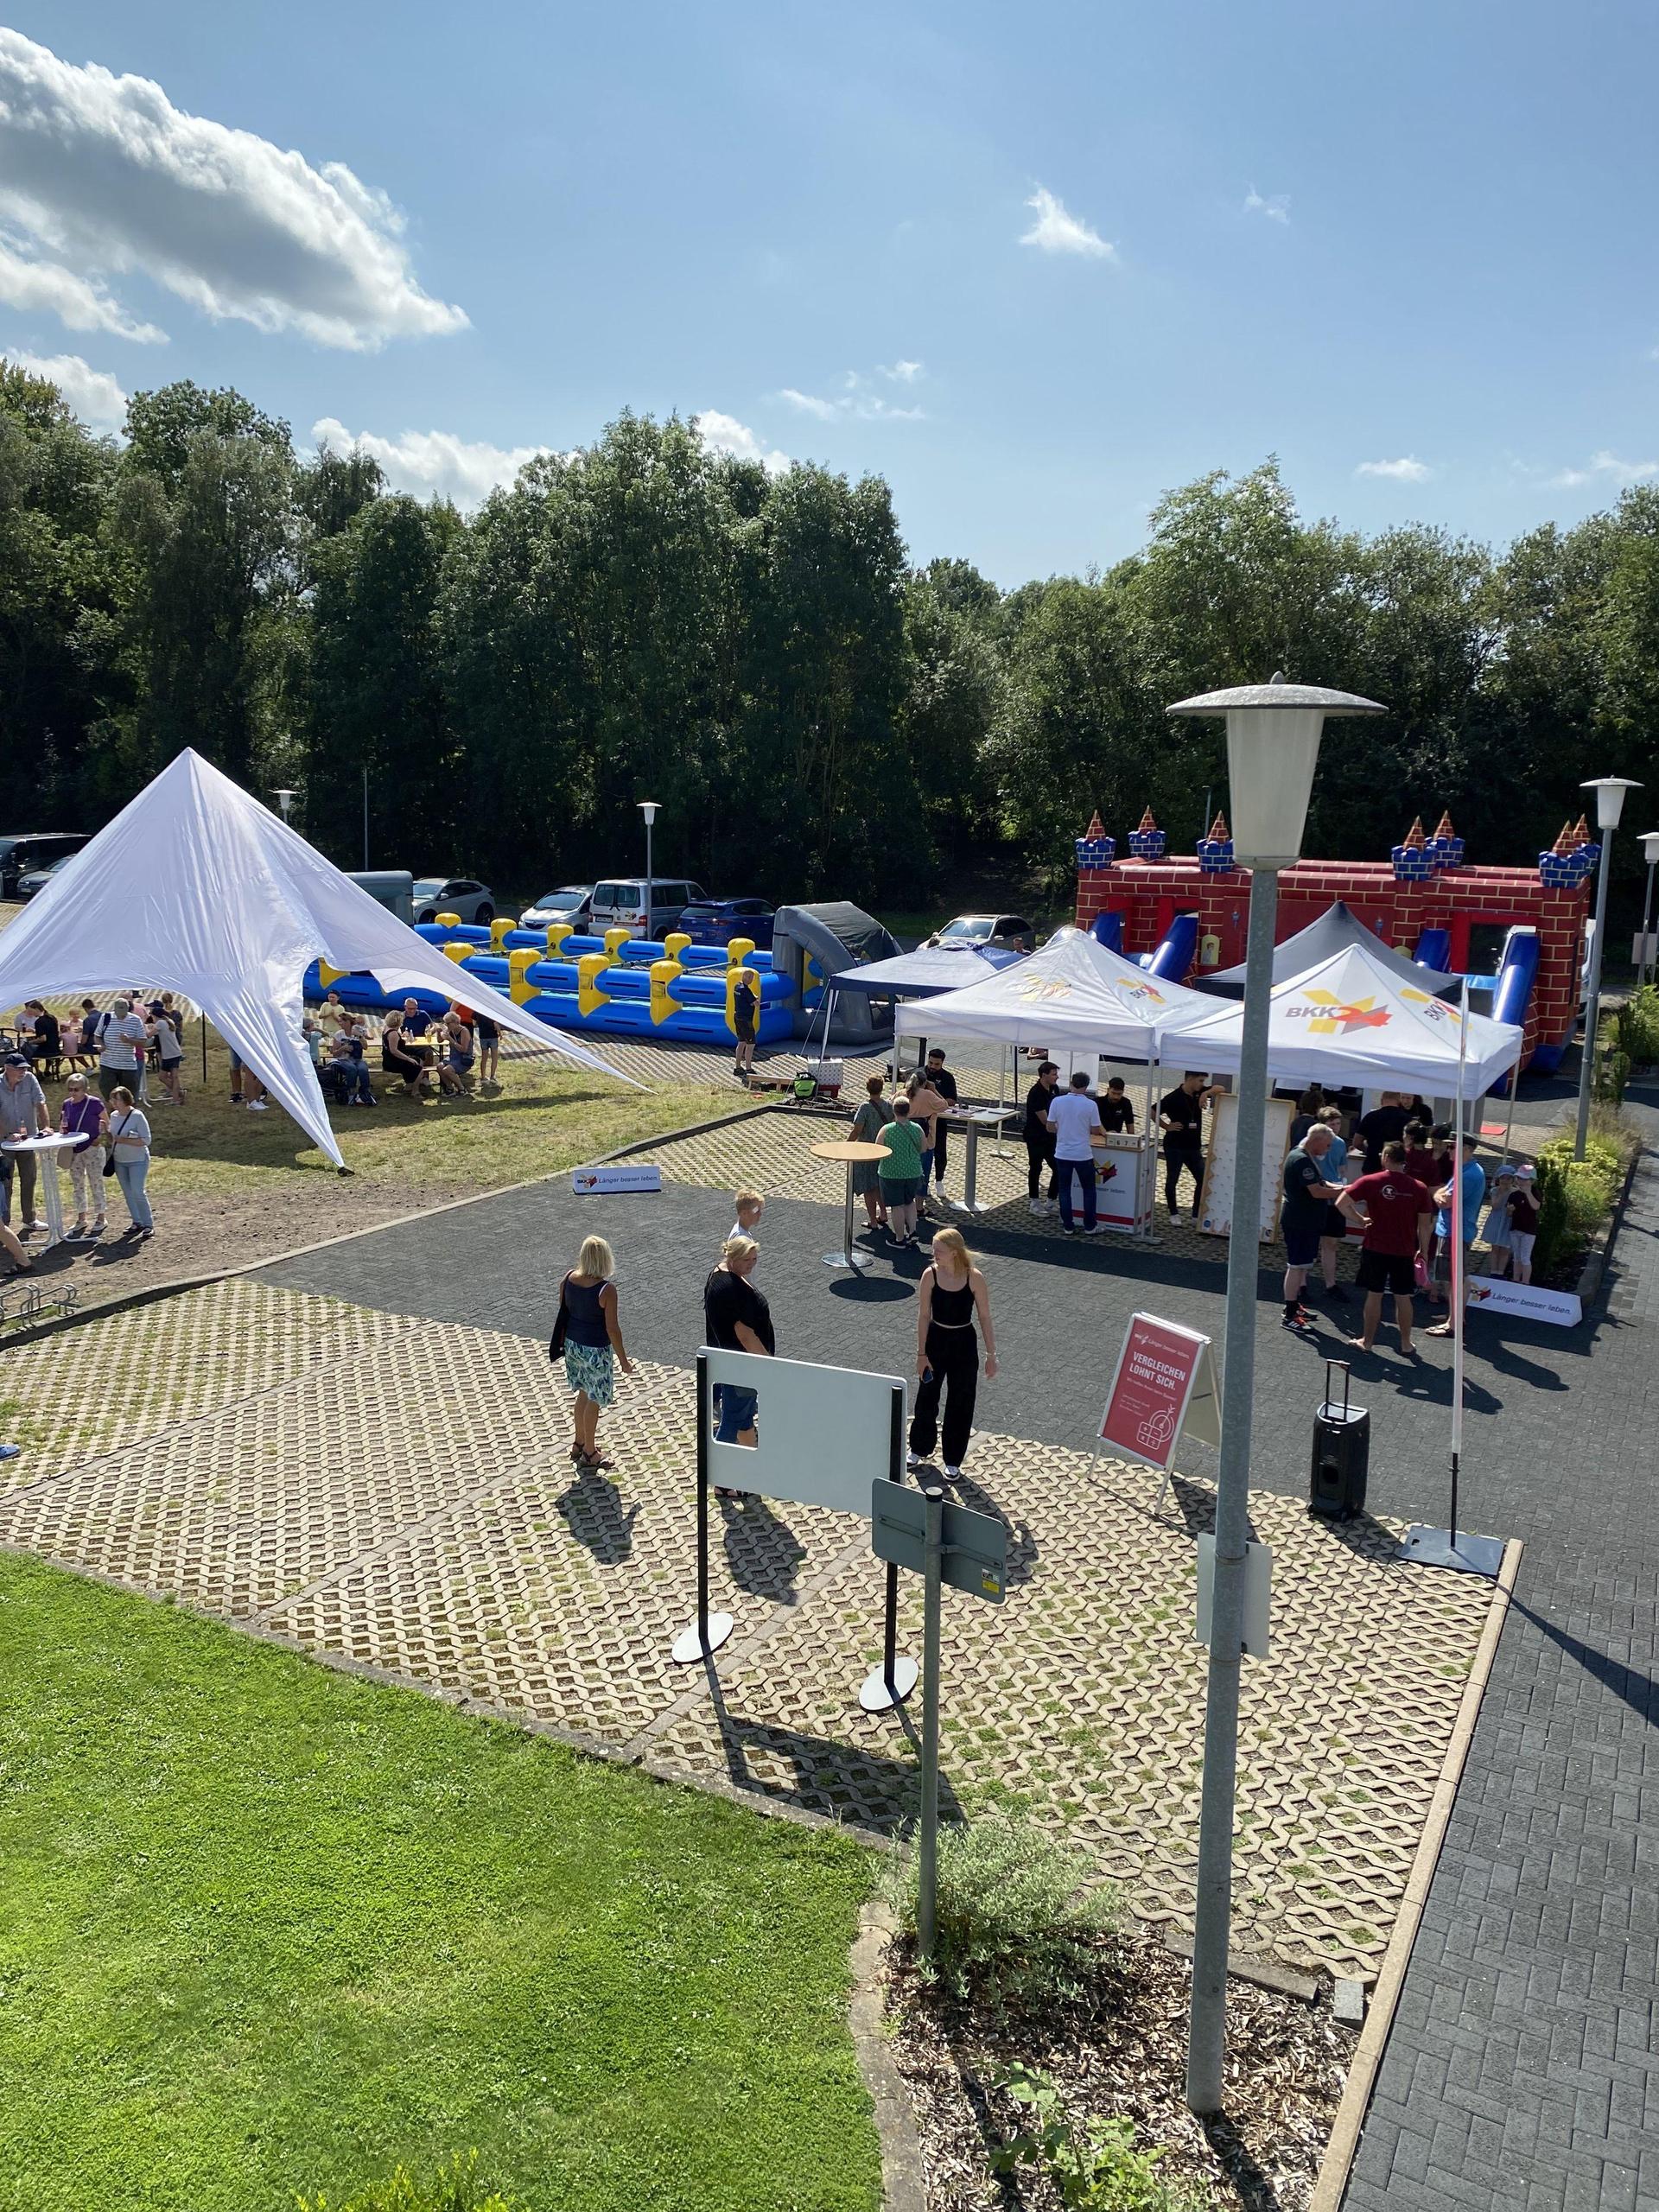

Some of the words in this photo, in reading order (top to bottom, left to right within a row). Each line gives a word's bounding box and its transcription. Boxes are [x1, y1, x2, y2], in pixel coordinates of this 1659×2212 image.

[1492, 1293, 1520, 1304] Länger
[1520, 1299, 1547, 1309] besser
[1129, 1363, 1156, 1381] LOHNT
[1155, 1374, 1176, 1390] SICH.
[1133, 1351, 1186, 1382] VERGLEICHEN
